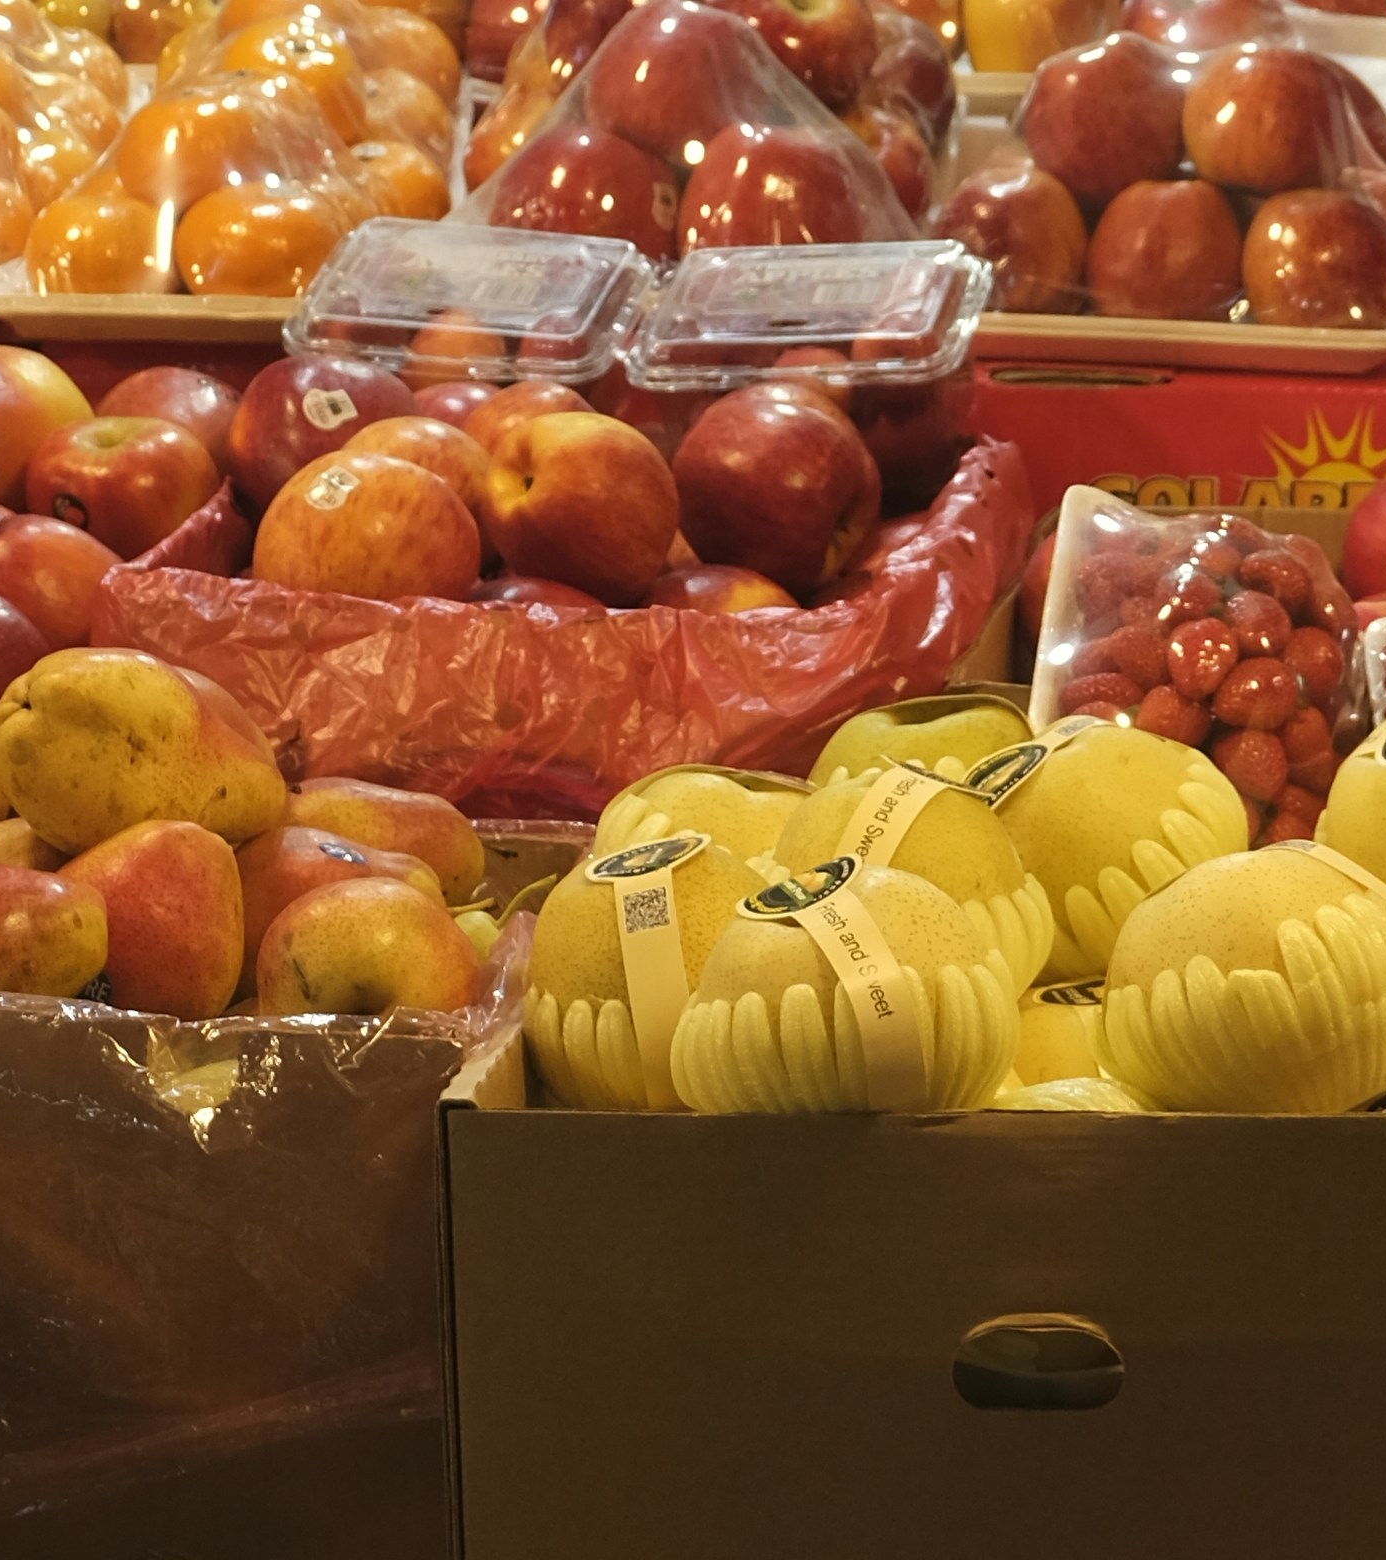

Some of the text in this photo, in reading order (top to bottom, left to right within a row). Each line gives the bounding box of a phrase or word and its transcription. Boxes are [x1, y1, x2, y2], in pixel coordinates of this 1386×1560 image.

[855, 777, 925, 863] resh and Swe
[813, 899, 848, 932] Fresh
[838, 931, 869, 963] and
